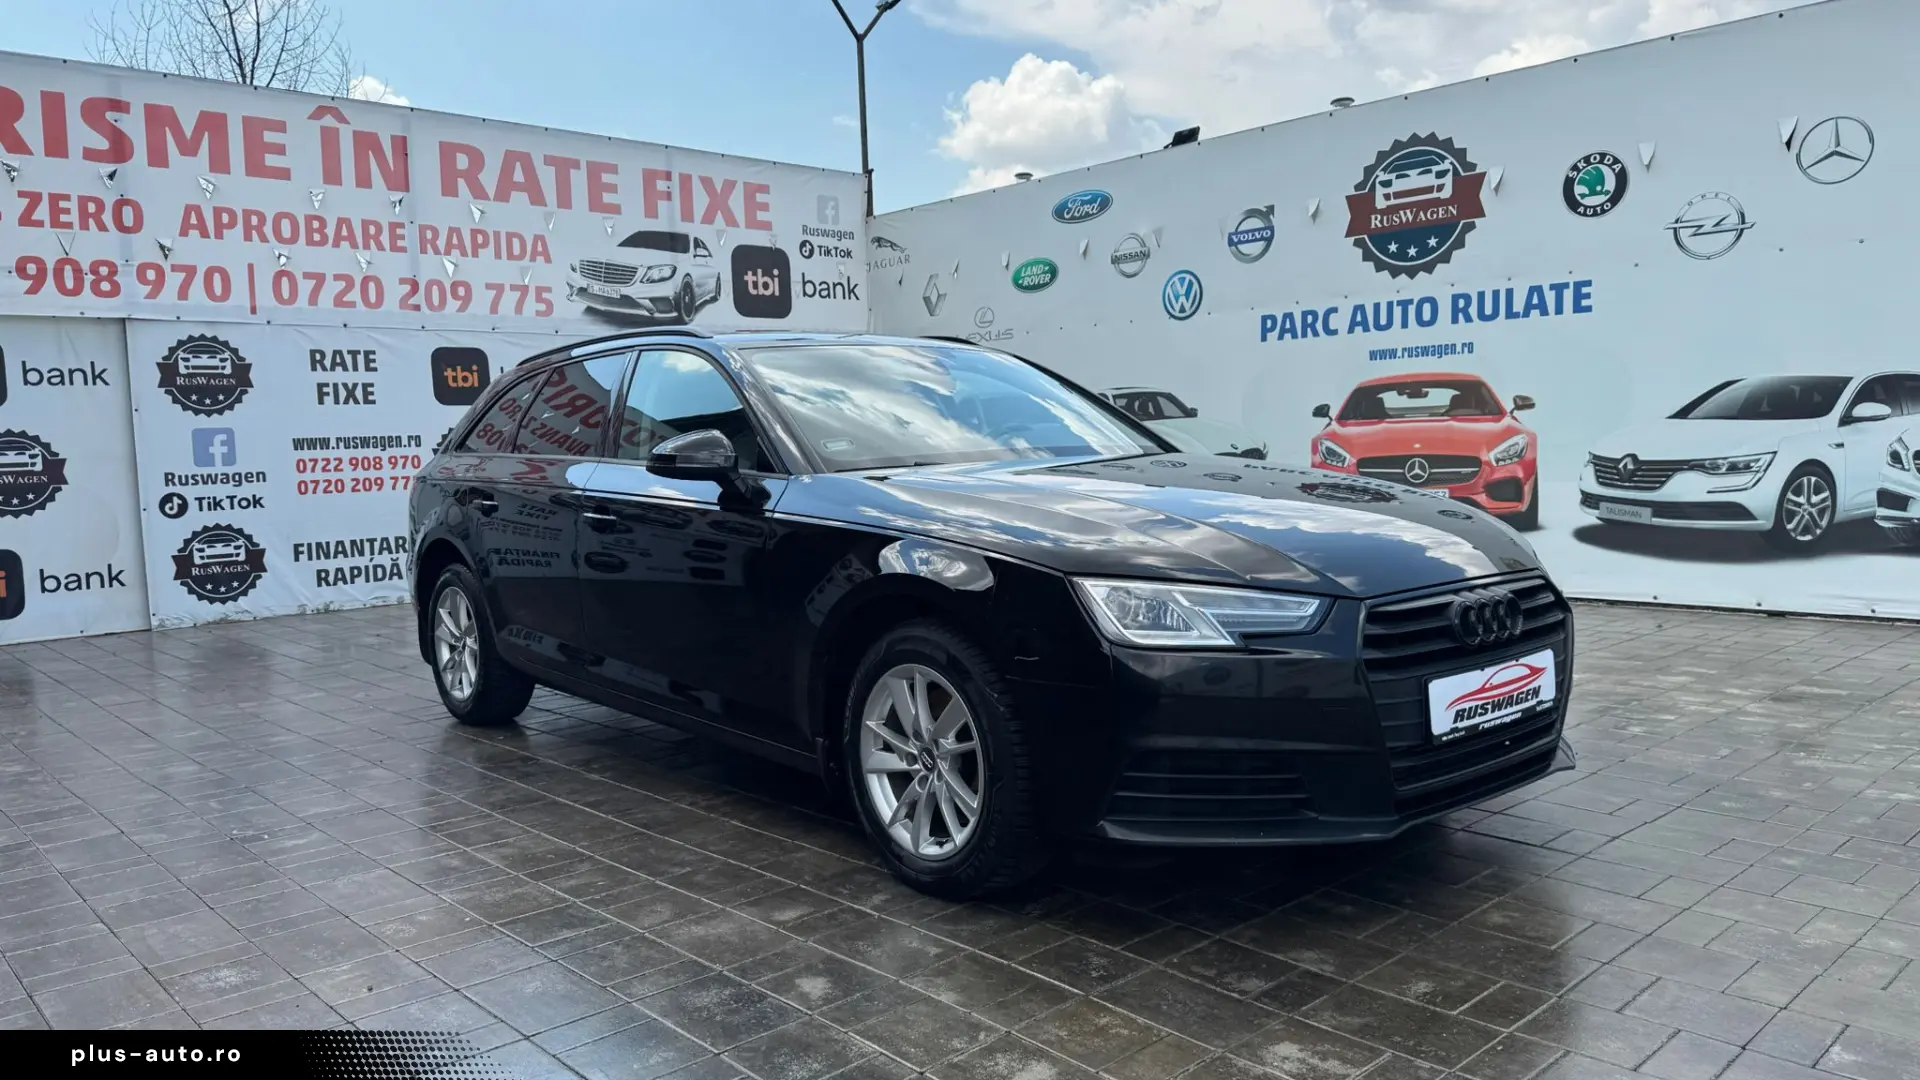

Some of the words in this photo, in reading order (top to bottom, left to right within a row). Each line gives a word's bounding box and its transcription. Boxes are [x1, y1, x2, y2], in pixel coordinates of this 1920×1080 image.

[307, 104, 411, 193] ÎN
[439, 140, 622, 215] RATE
[641, 167, 773, 231] FIXE
[1063, 194, 1102, 219] Ford
[1577, 202, 1611, 215] AUTO
[17, 190, 144, 234] ZERO
[178, 203, 408, 253] APROBARE
[418, 223, 553, 264] RAPIDA
[802, 224, 855, 241] Ruswagen
[1231, 229, 1271, 243] VOLVO
[817, 244, 854, 259] TikTok
[1113, 249, 1147, 262] NISSAN
[866, 253, 911, 273] JAGUAR
[1021, 263, 1044, 277] LAND
[15, 255, 121, 299] 908
[136, 261, 232, 303] 970
[272, 269, 385, 310] 0720
[398, 277, 473, 313] 209
[485, 282, 554, 318] 775
[743, 268, 780, 297] tbi
[801, 271, 860, 301] bank
[1022, 273, 1052, 287] ROVER
[1260, 305, 1339, 342] PARC
[1346, 295, 1440, 335] AUTO
[1450, 279, 1594, 325] RULATE
[956, 328, 1014, 343] EXUS
[309, 348, 378, 373] RATE
[1368, 340, 1474, 362] www.ruswagen.ro
[22, 361, 110, 387] bank
[443, 364, 480, 388] tbi
[316, 381, 377, 406] FIXE
[292, 434, 422, 452] www.ruswagen.ro
[296, 457, 344, 474] 0722
[349, 456, 384, 472] 908
[388, 454, 421, 471] 970
[164, 470, 267, 488] Ruswagen
[297, 478, 345, 495] 0720
[350, 476, 385, 493] 209
[390, 475, 413, 491] 77
[194, 494, 265, 512] TikTok
[1605, 506, 1643, 518] TALISMAN
[293, 535, 409, 563] FINANȚAR
[39, 563, 126, 594] bank
[1452, 685, 1542, 725] RUSWAGEN
